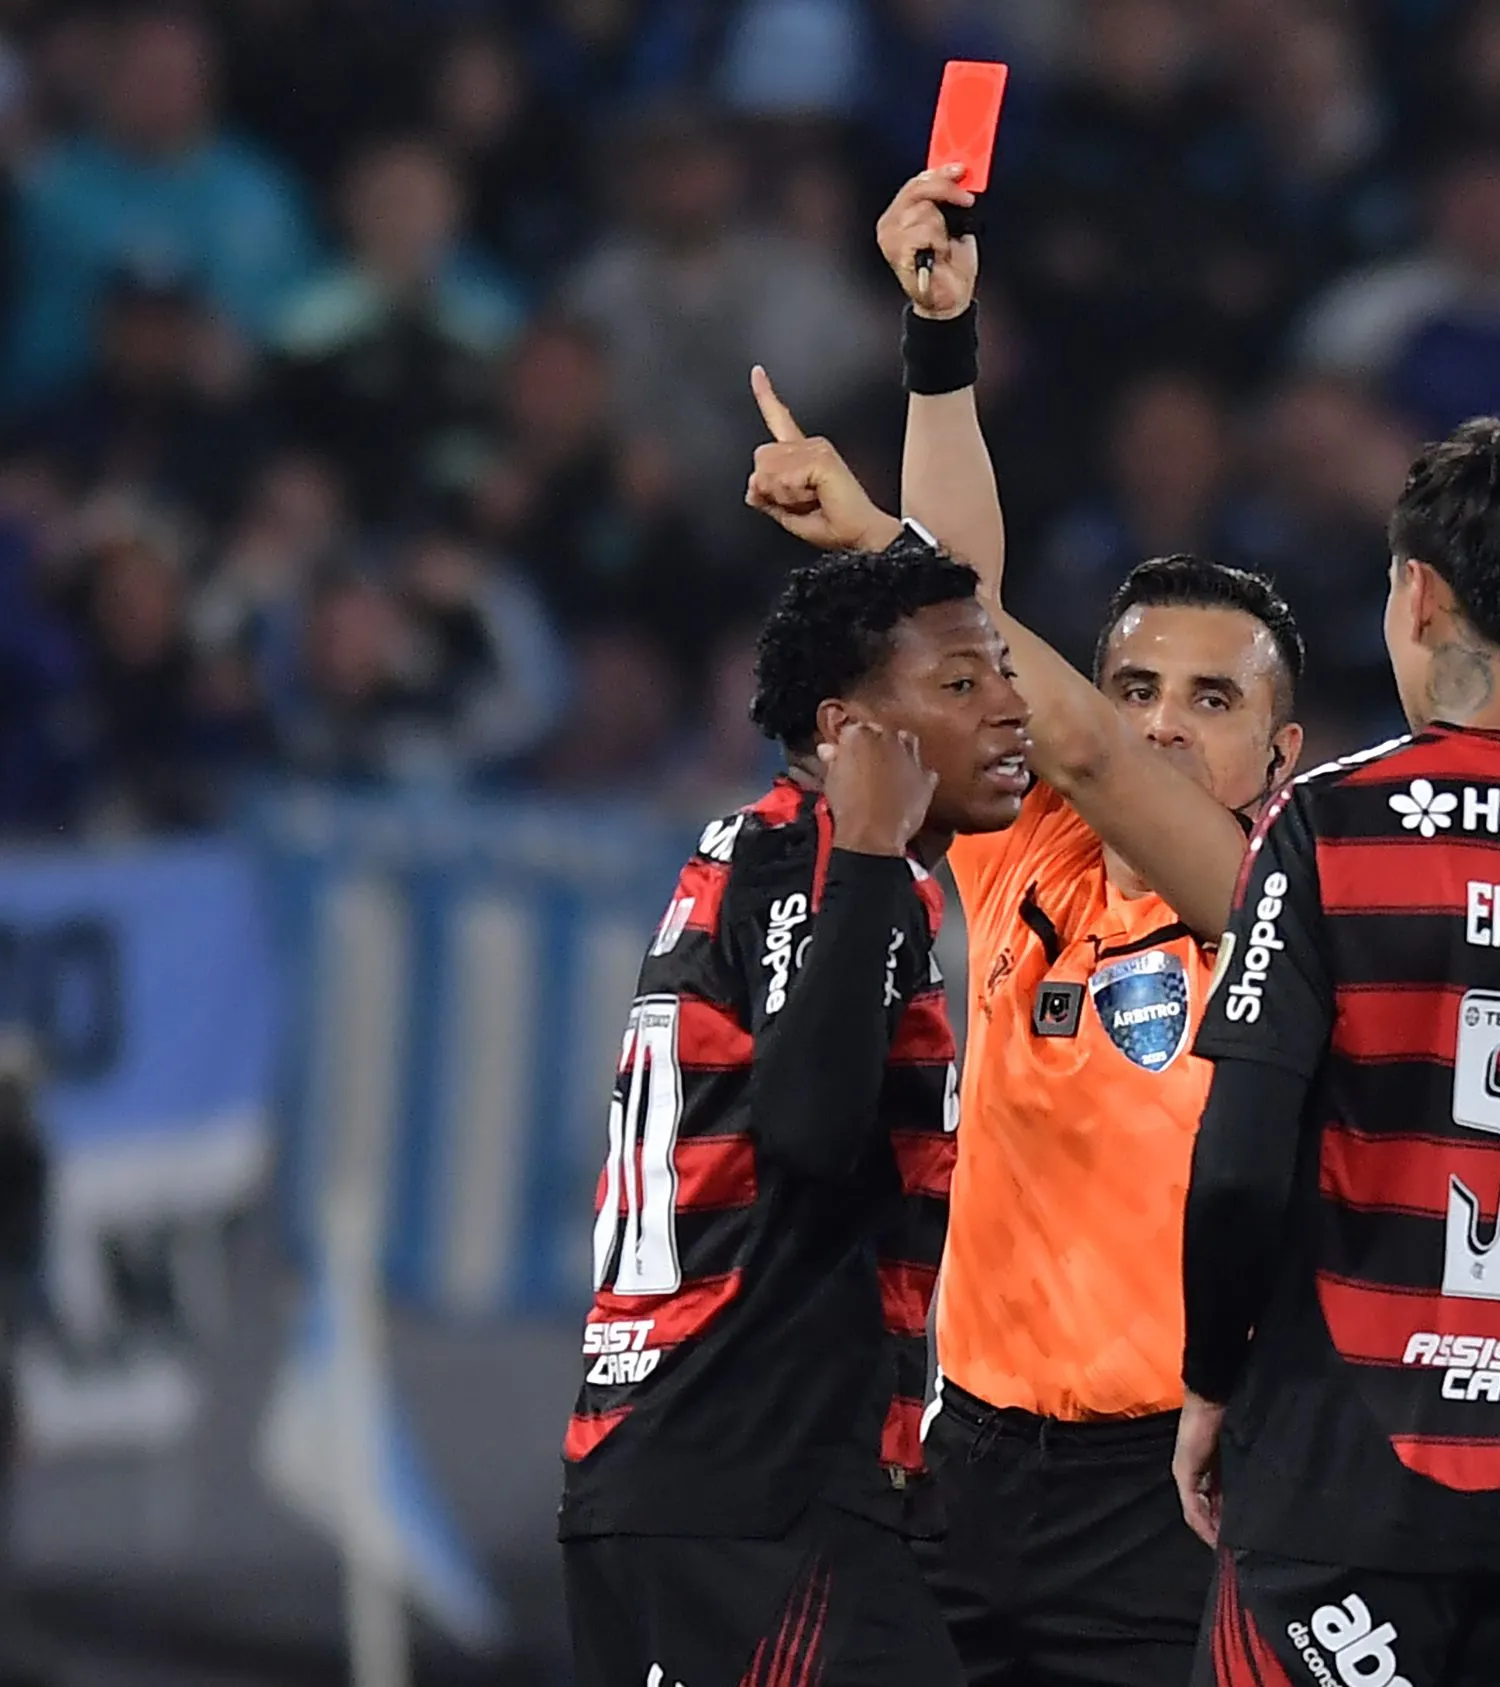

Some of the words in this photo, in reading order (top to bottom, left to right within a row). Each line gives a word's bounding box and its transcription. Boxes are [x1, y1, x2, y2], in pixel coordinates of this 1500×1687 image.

[1226, 871, 1288, 1024] Shopee
[1113, 1002, 1180, 1028] ÁRBITRO
[586, 1348, 661, 1385] CARD
[1287, 1622, 1310, 1650] da
